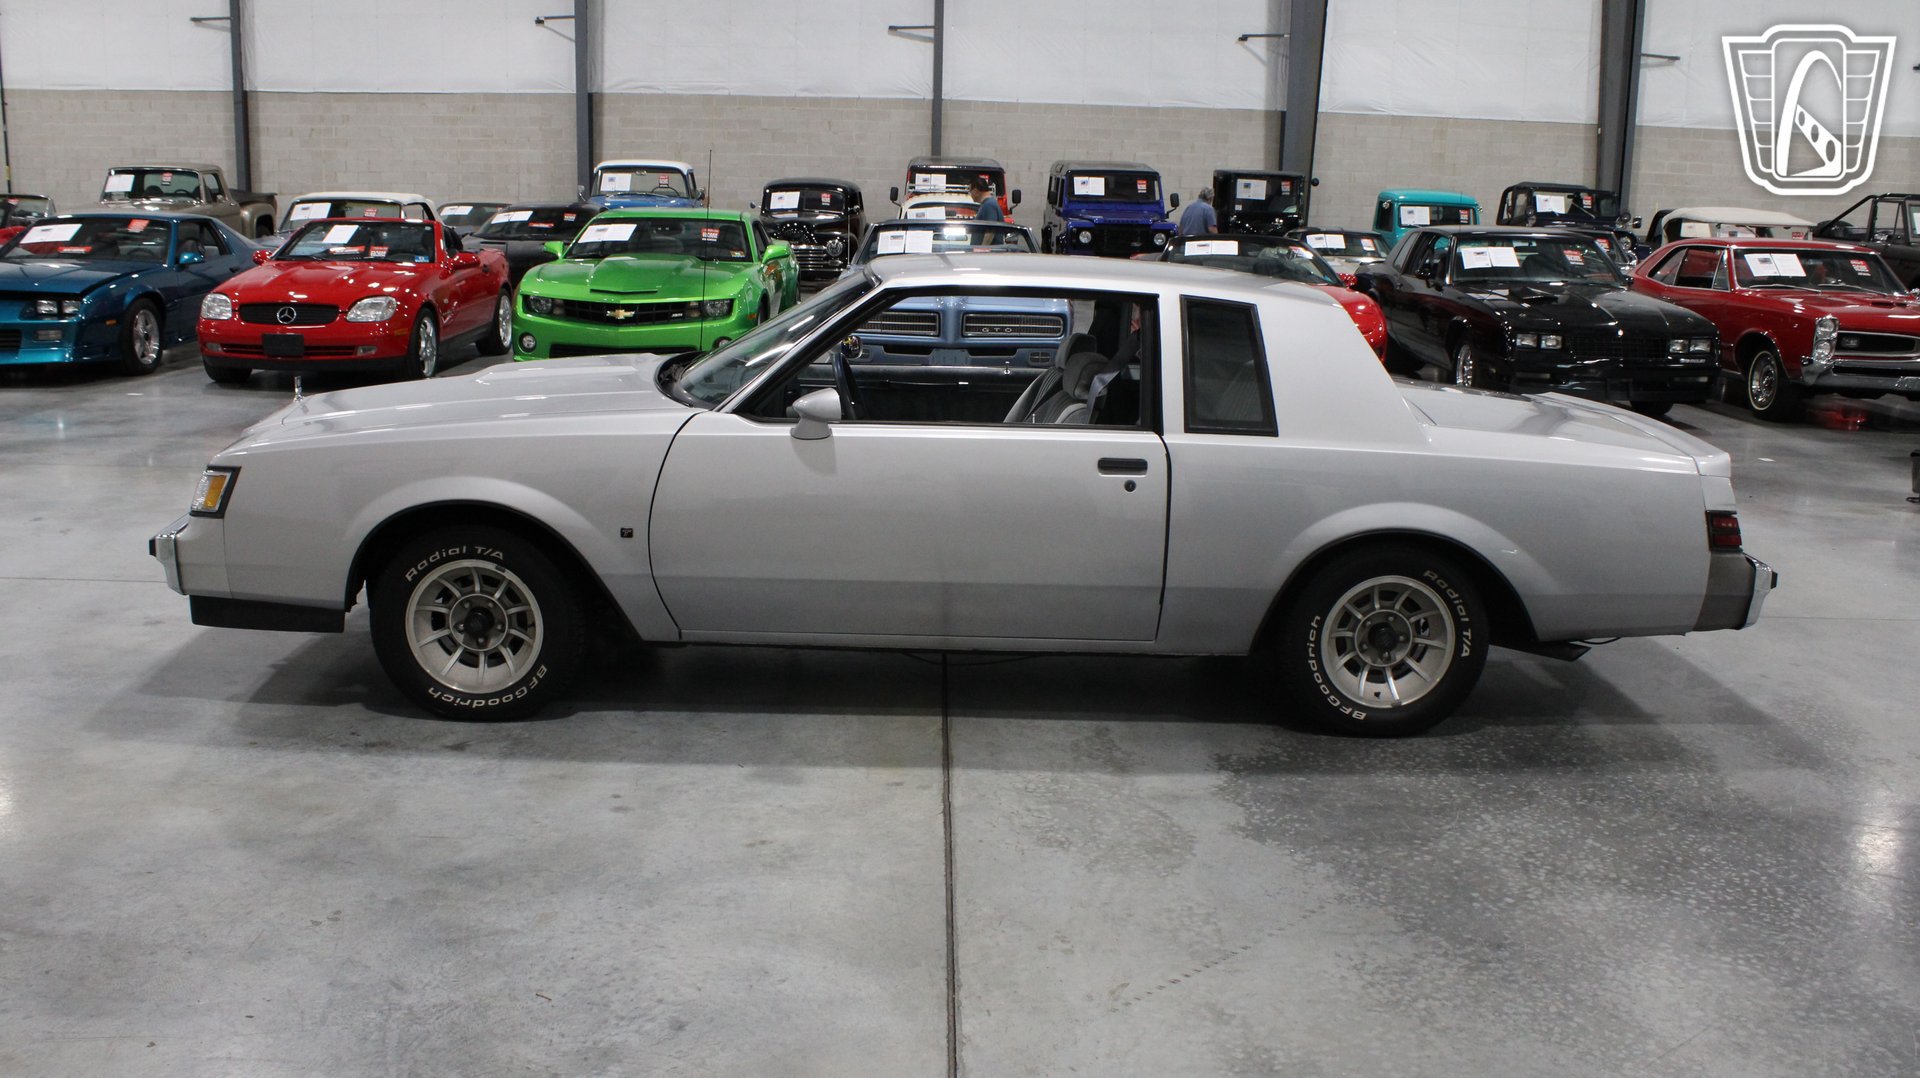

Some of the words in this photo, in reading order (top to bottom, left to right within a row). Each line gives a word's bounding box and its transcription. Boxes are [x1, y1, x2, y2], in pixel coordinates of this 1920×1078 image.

[405, 545, 467, 582] Radial
[475, 545, 504, 560] T/A
[1423, 569, 1470, 628] Radial
[1461, 628, 1472, 658] T/A
[428, 664, 548, 708] BFGoodrich
[1306, 615, 1367, 721] BFGoodrich
